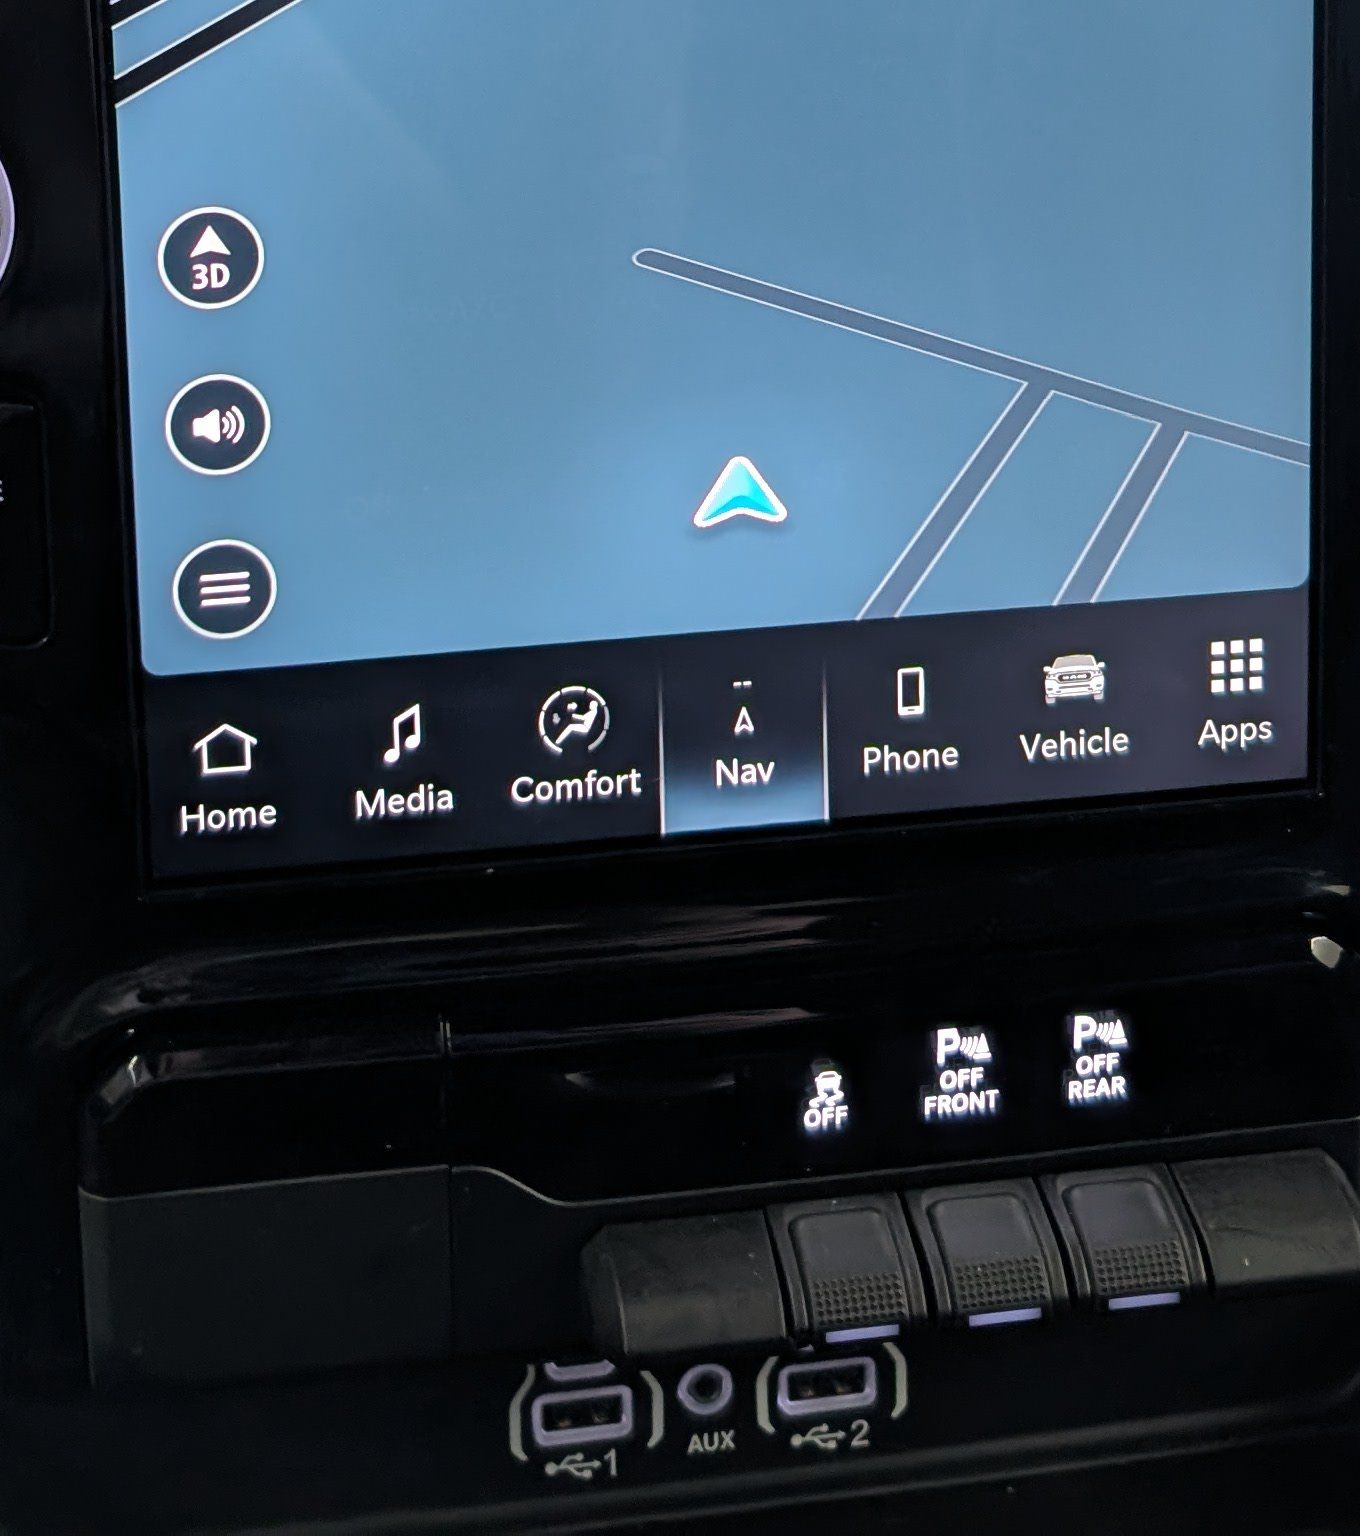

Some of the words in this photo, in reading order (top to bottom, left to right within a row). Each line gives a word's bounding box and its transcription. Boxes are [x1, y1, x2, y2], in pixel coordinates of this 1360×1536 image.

[192, 262, 231, 290] 3D
[1019, 726, 1129, 762] Vehicle
[1197, 719, 1273, 750] Apps
[715, 757, 776, 788] Nav
[863, 744, 959, 776] Phone
[355, 783, 454, 819] Media
[511, 768, 642, 803] Comfort
[181, 803, 277, 834] Home
[939, 1067, 985, 1090] OFF
[1075, 1052, 1120, 1074] OFF
[1068, 1075, 1126, 1100] REAR
[804, 1105, 849, 1128] OFF
[924, 1089, 1000, 1118] FRONT
[687, 1429, 735, 1454] AUX
[850, 1418, 872, 1450] 2
[605, 1447, 619, 1479] 1
